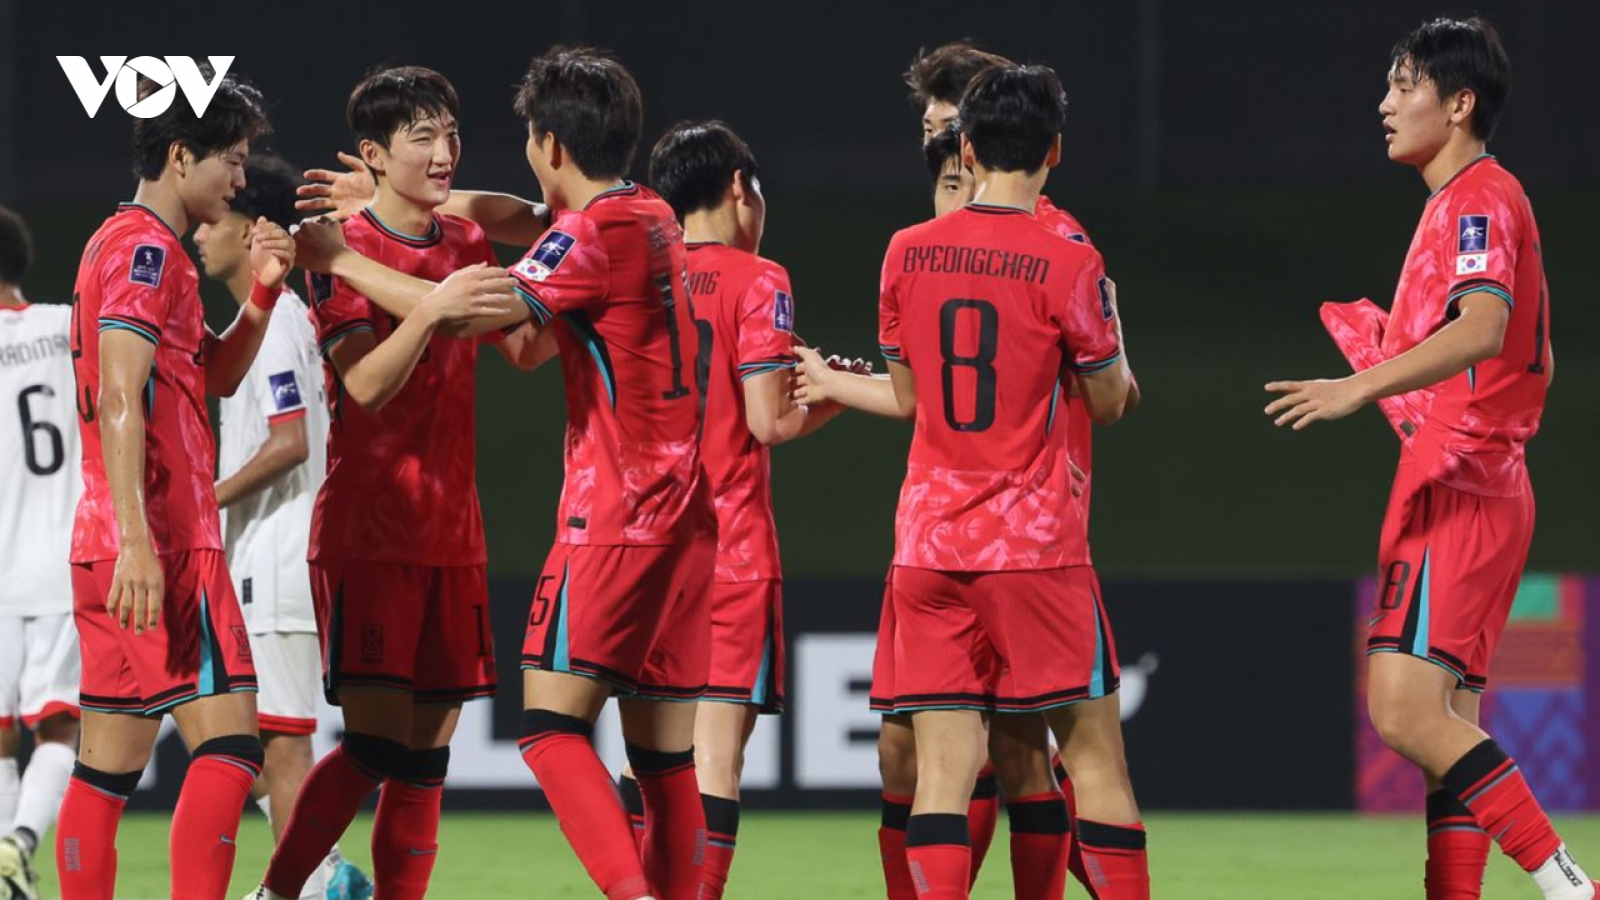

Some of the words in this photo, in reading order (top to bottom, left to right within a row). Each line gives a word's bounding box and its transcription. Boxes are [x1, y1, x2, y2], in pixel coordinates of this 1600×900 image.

[1461, 226, 1484, 238] AFC
[903, 246, 1050, 285] BYEONGCHAN
[940, 298, 999, 432] 8
[18, 384, 65, 476] 6
[530, 575, 555, 626] 5
